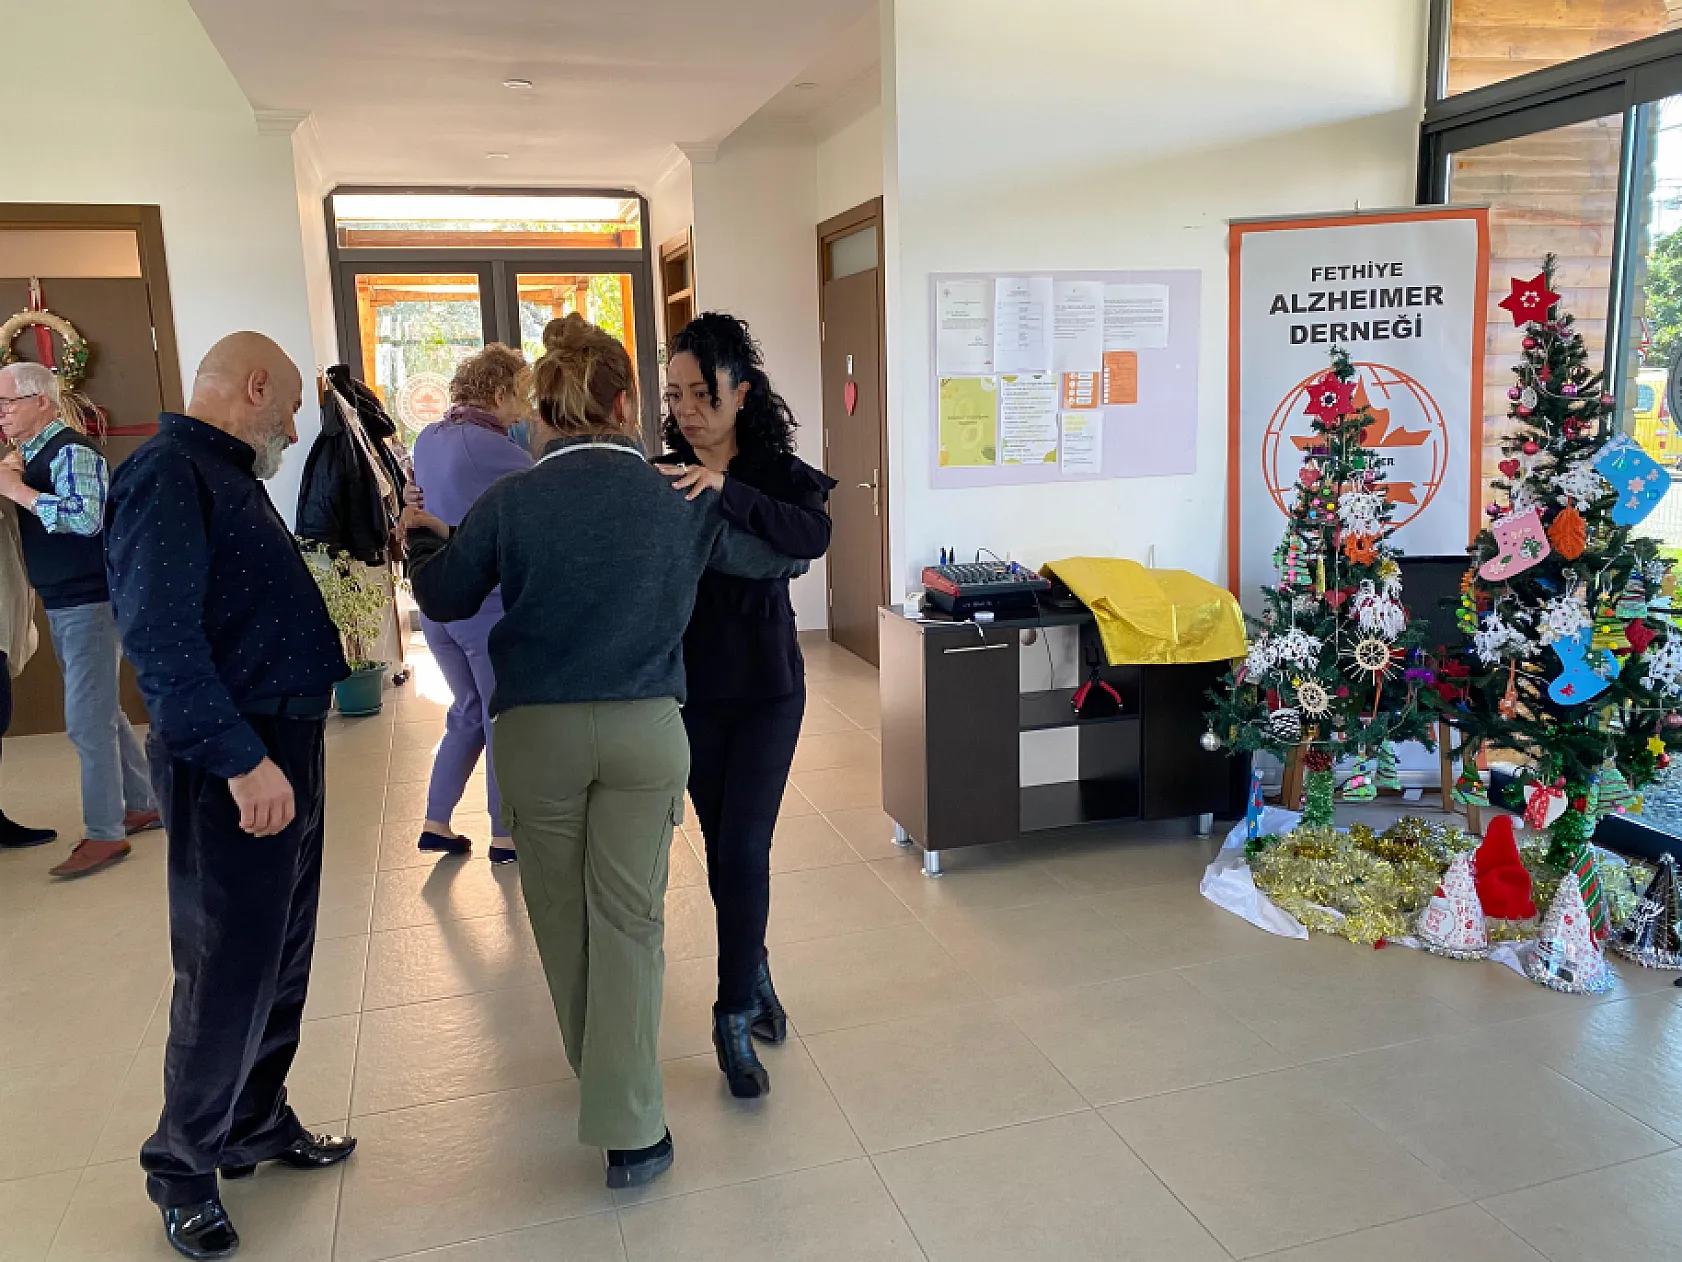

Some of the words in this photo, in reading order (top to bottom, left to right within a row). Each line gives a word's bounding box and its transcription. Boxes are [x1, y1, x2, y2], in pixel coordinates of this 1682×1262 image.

[1312, 261, 1403, 282] FETHİYE
[1269, 285, 1444, 315] ALZHEIMER
[1290, 313, 1423, 345] DERNEĞİ
